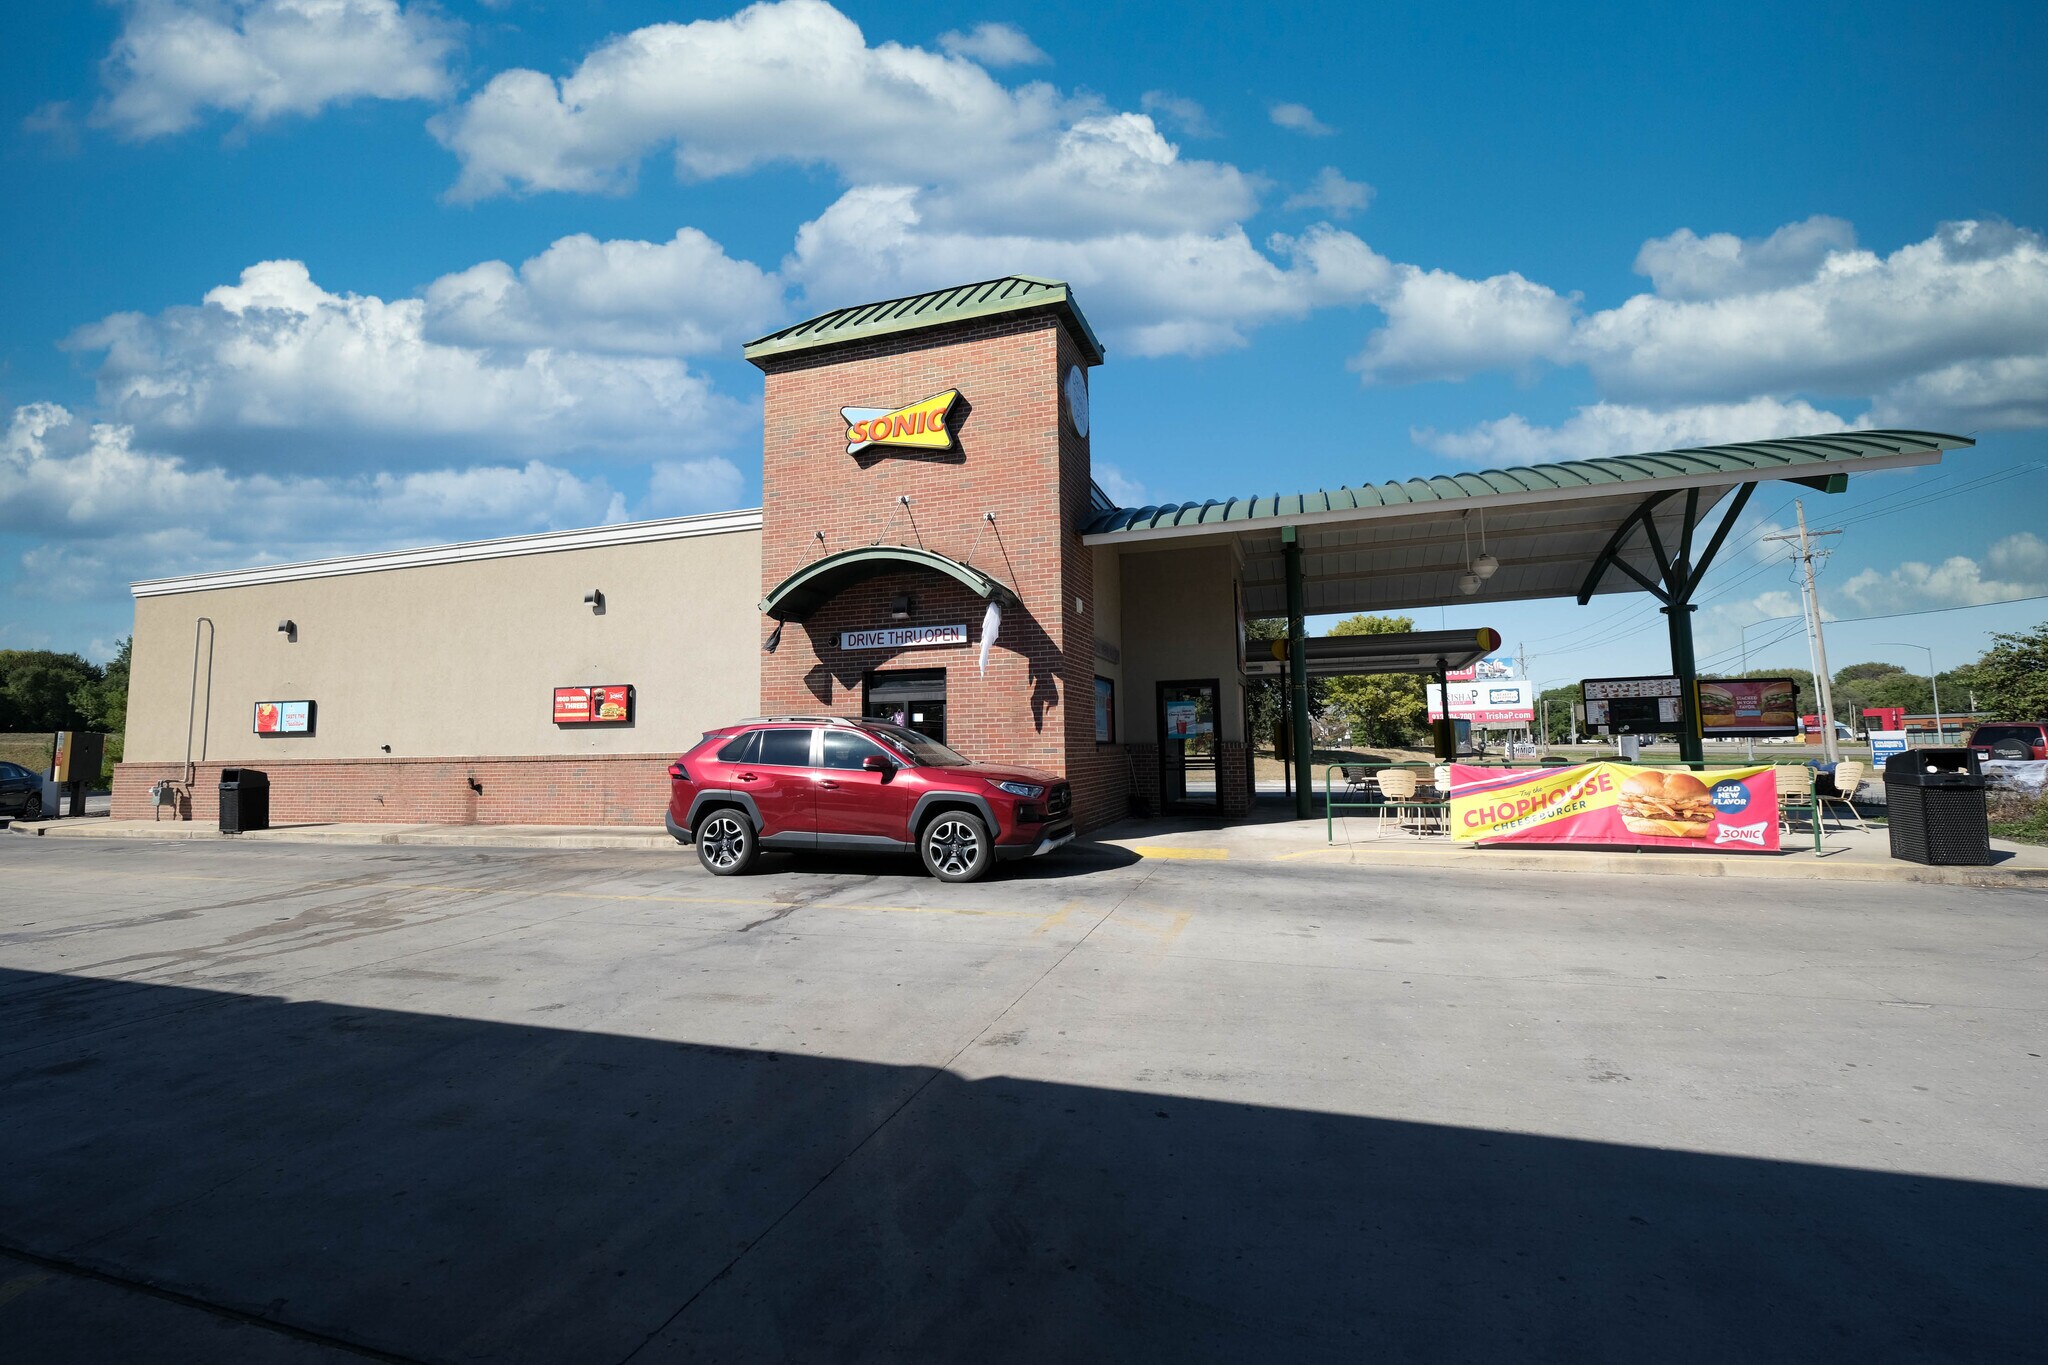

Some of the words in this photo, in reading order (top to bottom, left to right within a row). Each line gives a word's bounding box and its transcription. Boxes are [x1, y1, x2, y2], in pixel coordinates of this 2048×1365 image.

[850, 407, 947, 444] SONIC
[848, 632, 885, 647] DRIVE
[888, 629, 922, 644] THRU
[924, 627, 960, 643] OPEN
[1486, 712, 1530, 720] TrishaP.com
[1507, 746, 1535, 754] SHMIDT
[1519, 789, 1532, 797] Try
[1463, 773, 1613, 828] CHOPHOUSE
[1493, 800, 1587, 832] CHEESEBURGER
[1721, 830, 1760, 838] SONIC
